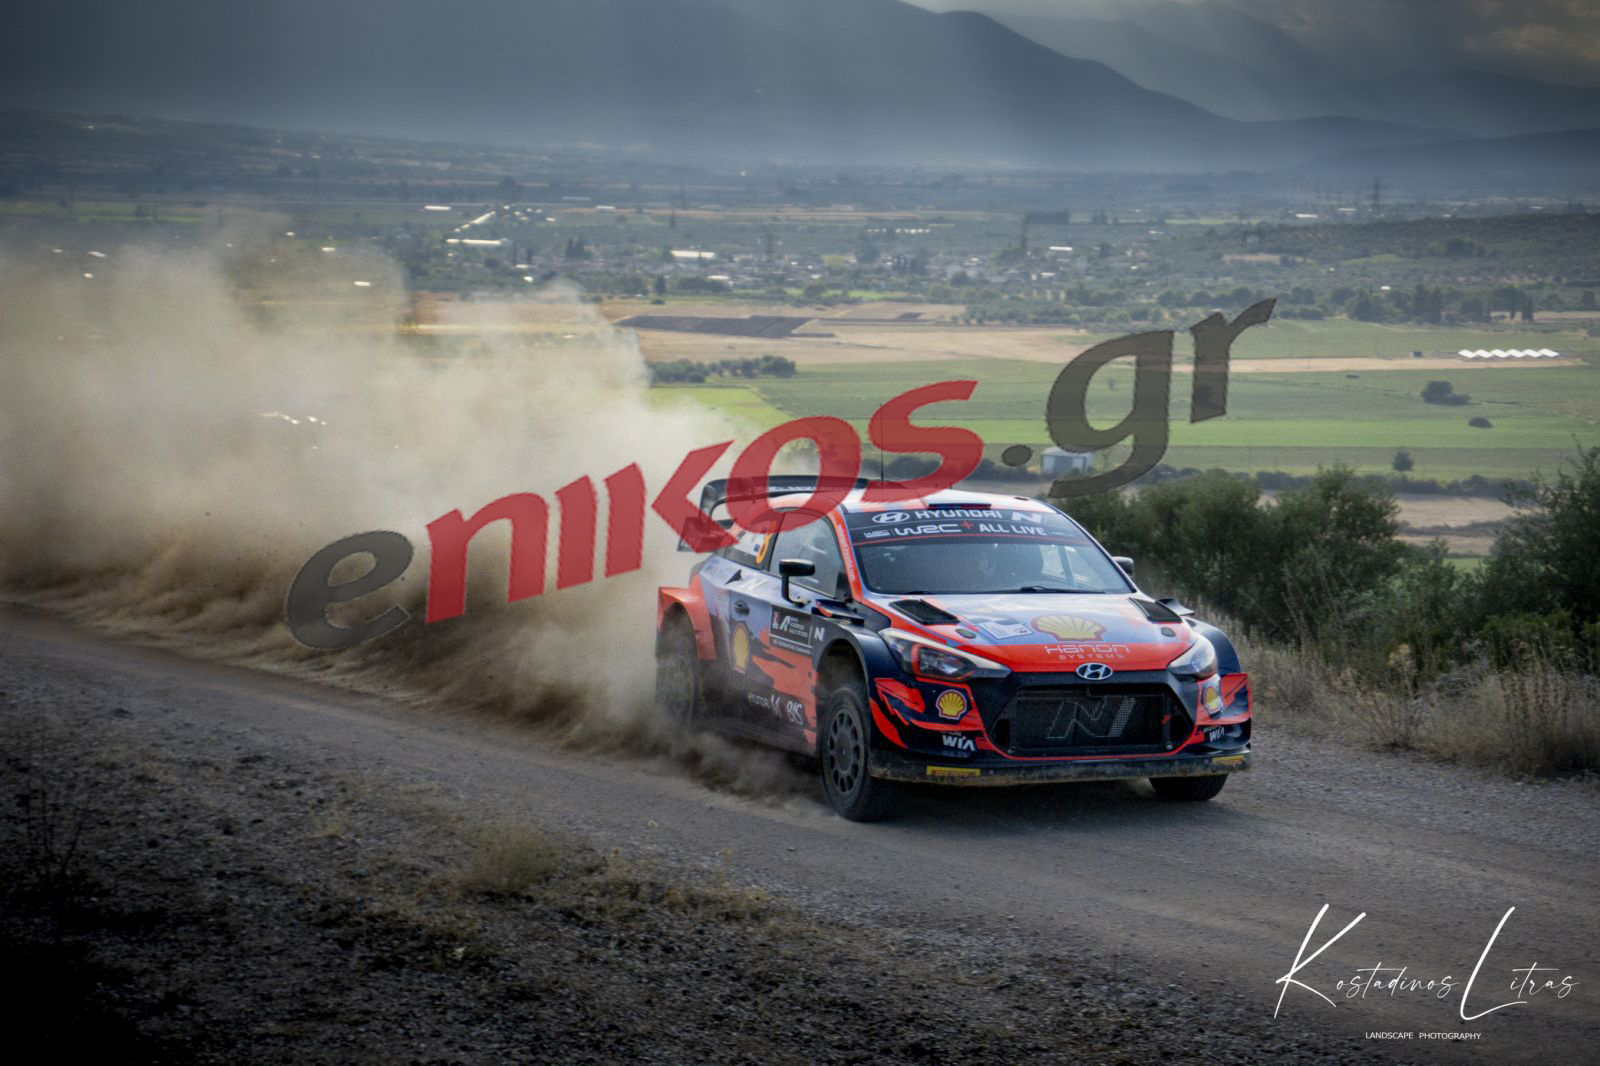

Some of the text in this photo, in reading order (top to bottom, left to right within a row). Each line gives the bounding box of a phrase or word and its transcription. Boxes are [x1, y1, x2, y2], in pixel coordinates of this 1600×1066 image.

[914, 509, 1003, 519] HYUNDAI
[979, 523, 1010, 533] ALL
[1010, 525, 1048, 536] LIVE
[813, 626, 826, 642] N
[1058, 652, 1124, 660] SYSTEMS
[942, 734, 976, 751] WIA
